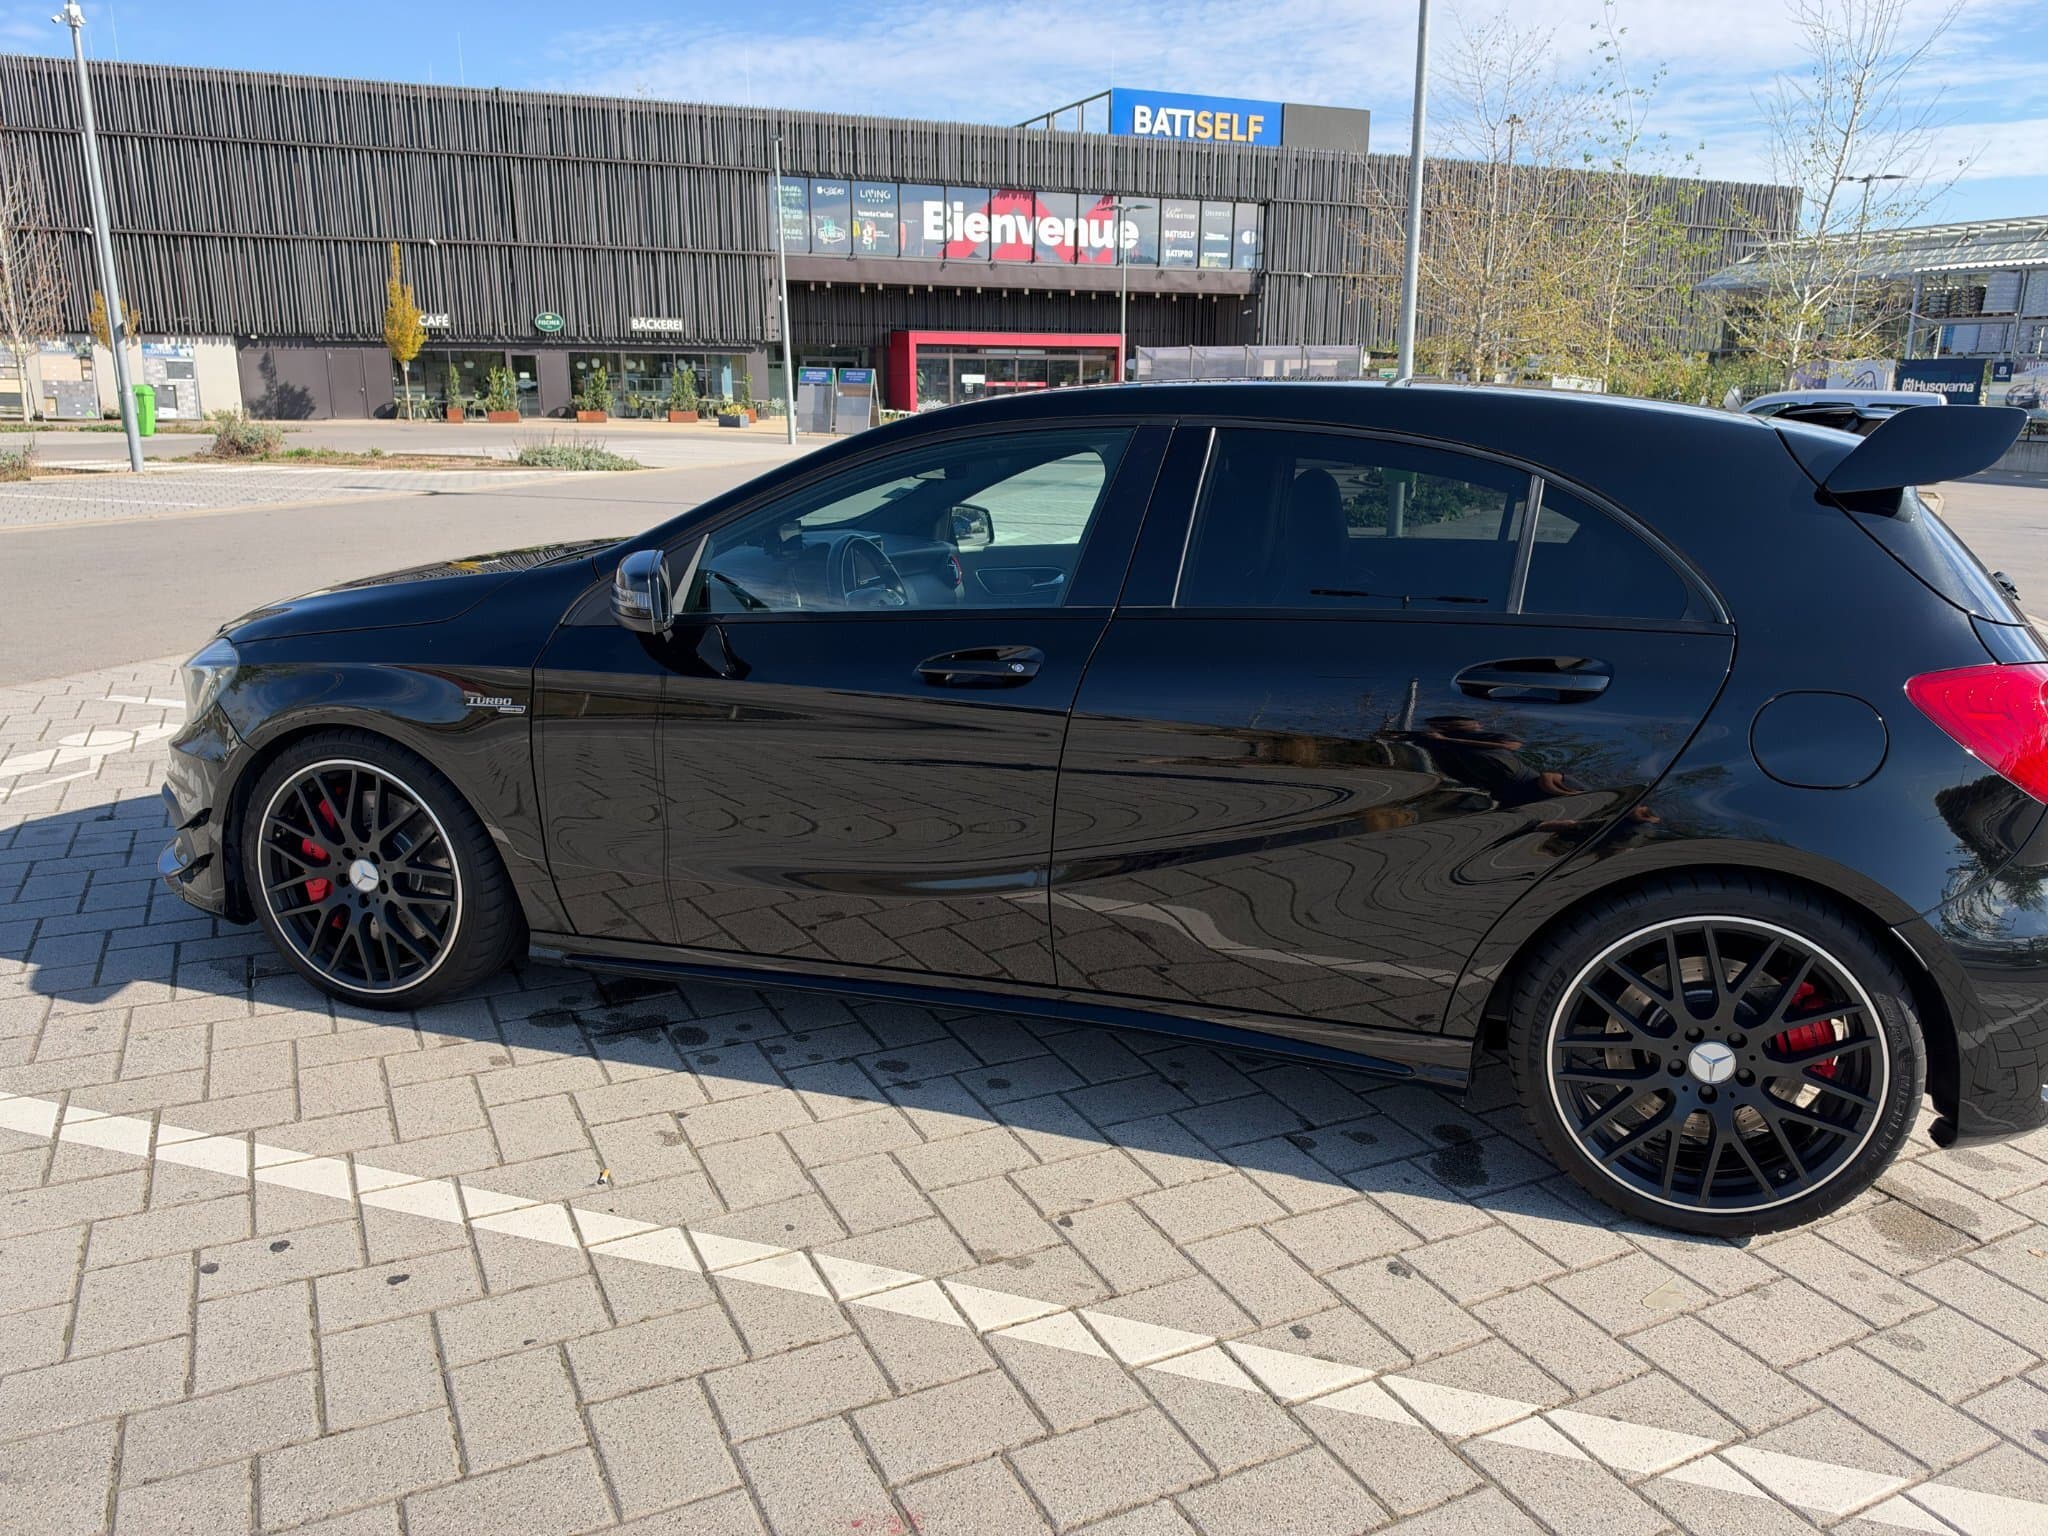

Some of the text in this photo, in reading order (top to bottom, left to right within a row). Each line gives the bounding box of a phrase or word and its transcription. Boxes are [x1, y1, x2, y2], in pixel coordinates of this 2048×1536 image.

[1134, 105, 1264, 142] BATISELF
[860, 189, 891, 199] LIVING
[923, 201, 1140, 249] Bienvenue
[418, 313, 449, 326] CAFÉ
[632, 317, 683, 331] BÄCKEREI
[1914, 380, 1975, 394] Husqvarna
[467, 696, 513, 705] TURBO
